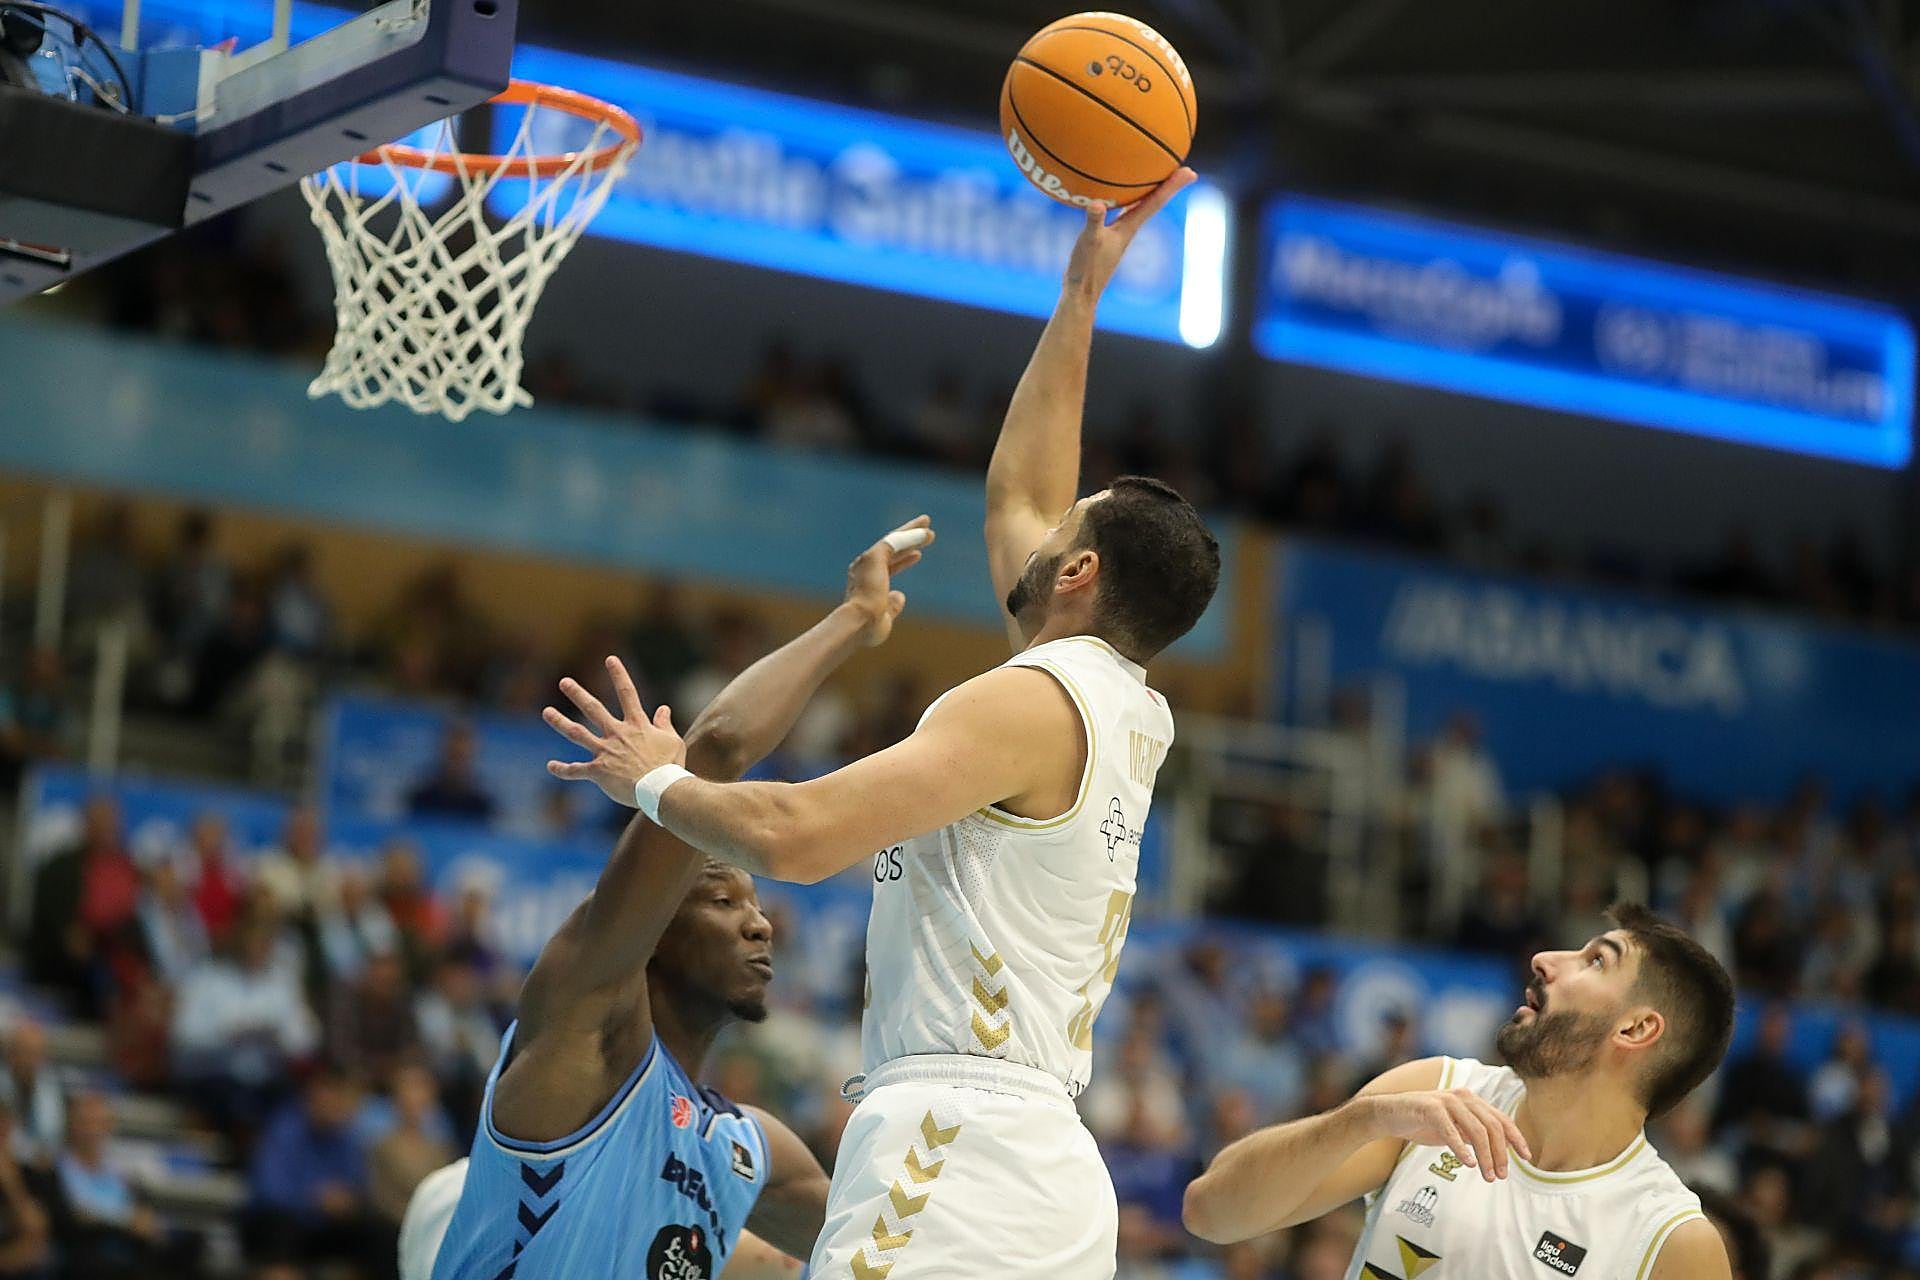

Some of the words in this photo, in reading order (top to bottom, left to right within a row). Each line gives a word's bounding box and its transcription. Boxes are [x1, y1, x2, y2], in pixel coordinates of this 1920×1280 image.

[1106, 55, 1152, 93] acb
[1540, 1240, 1560, 1256] liga
[1536, 1250, 1577, 1274] endesa
